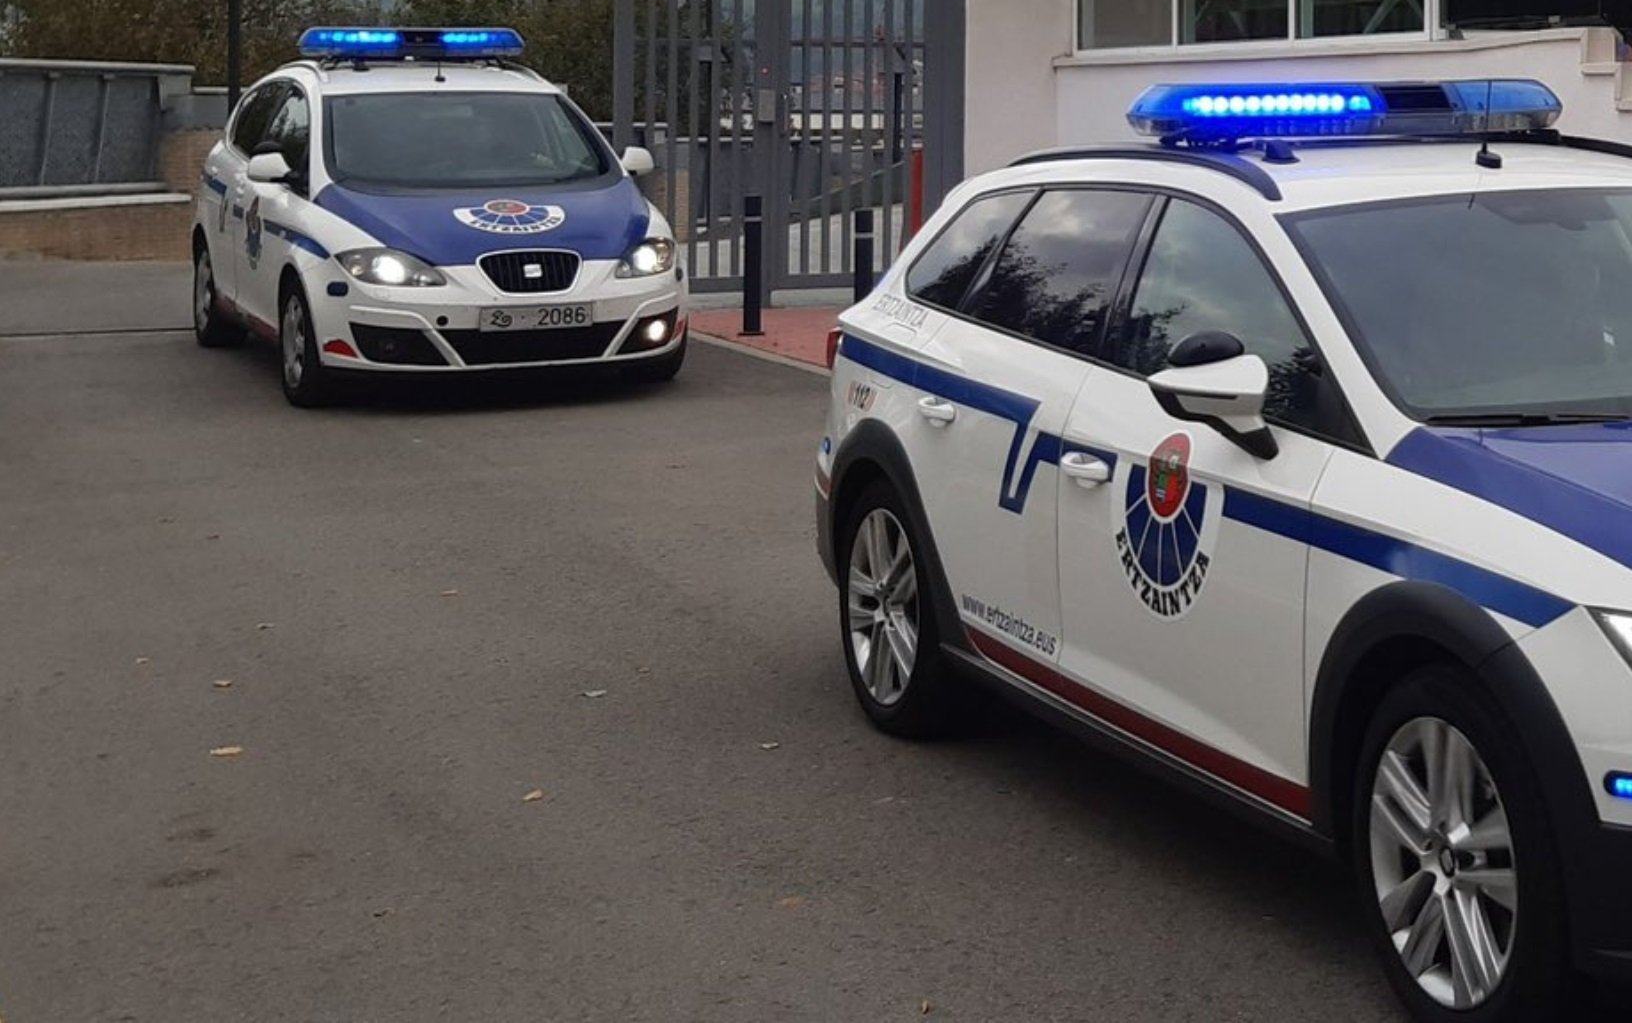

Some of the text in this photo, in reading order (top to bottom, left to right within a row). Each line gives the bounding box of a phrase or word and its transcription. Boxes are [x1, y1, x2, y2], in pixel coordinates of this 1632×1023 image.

[537, 306, 587, 326] 2086
[1115, 526, 1211, 617] ERTZAINTZA
[961, 593, 1057, 656] www.ertzaintza.eus
